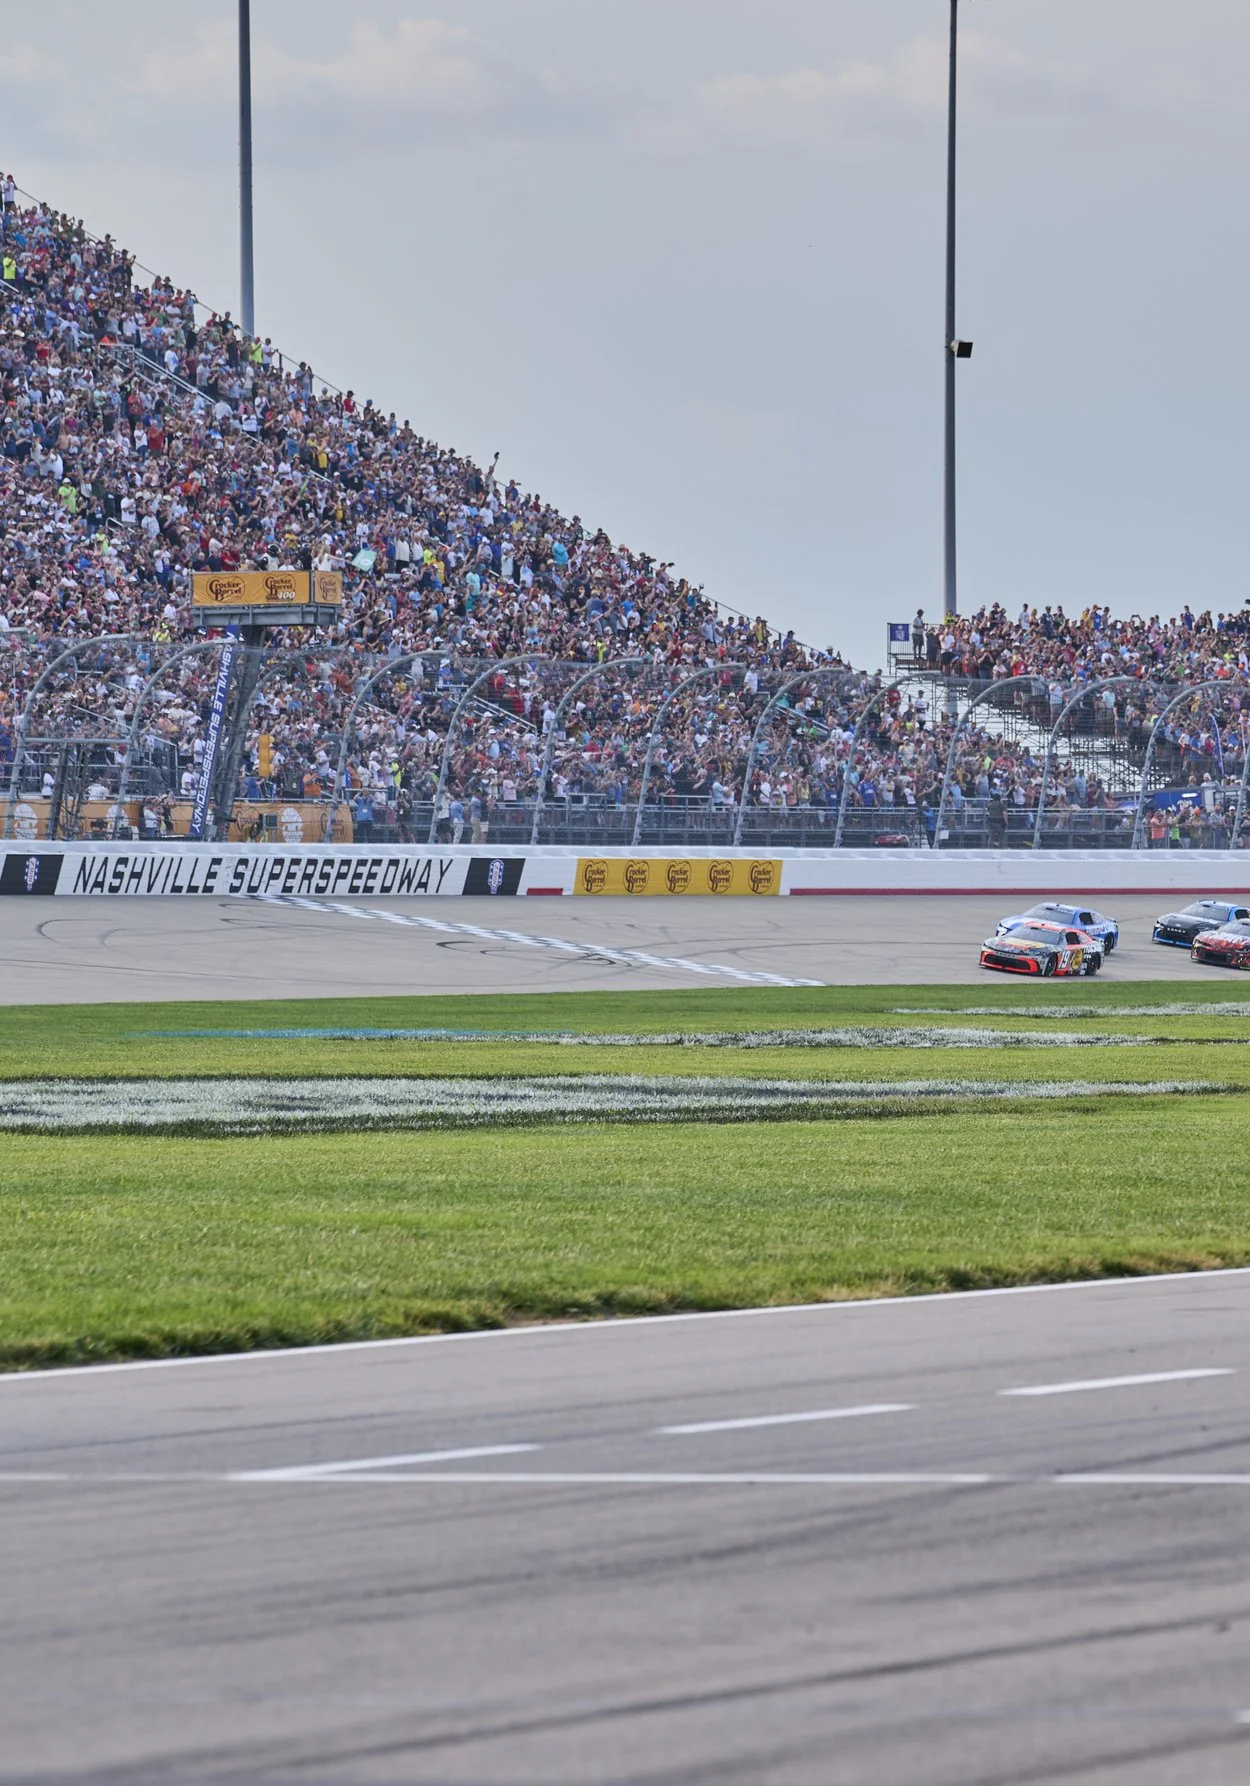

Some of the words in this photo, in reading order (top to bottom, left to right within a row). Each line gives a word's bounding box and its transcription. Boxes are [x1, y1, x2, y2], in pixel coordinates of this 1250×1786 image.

[209, 579, 241, 593] Cracker
[265, 577, 292, 589] Cracker
[193, 714, 221, 834] SUPERSPEEDWAY
[73, 856, 223, 894] NASHVILLE
[229, 857, 453, 894] SUPERSPEEDWAY
[1058, 950, 1071, 969] 19
